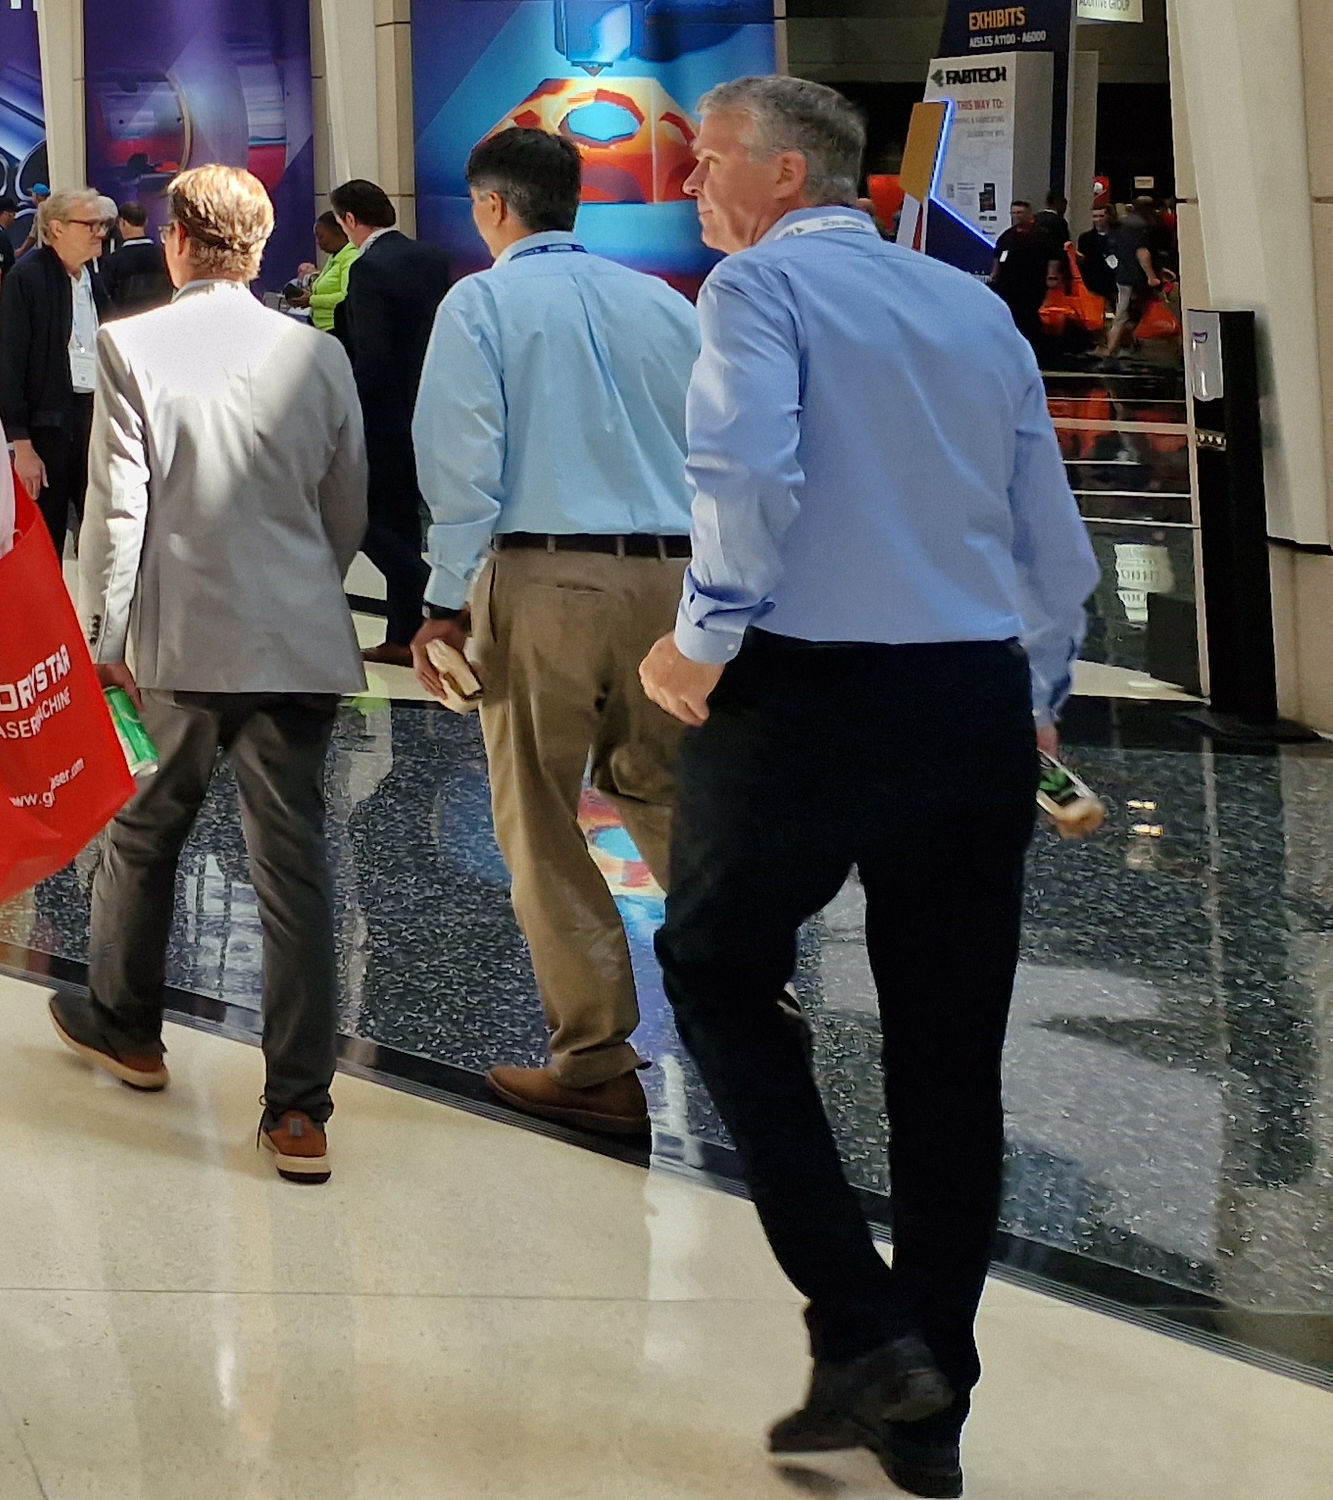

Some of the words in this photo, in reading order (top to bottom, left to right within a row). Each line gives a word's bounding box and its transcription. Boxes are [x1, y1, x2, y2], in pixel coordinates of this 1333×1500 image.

[968, 6, 1026, 32] EXHIBITS
[946, 66, 1007, 85] FABTECH
[974, 99, 989, 110] WAY
